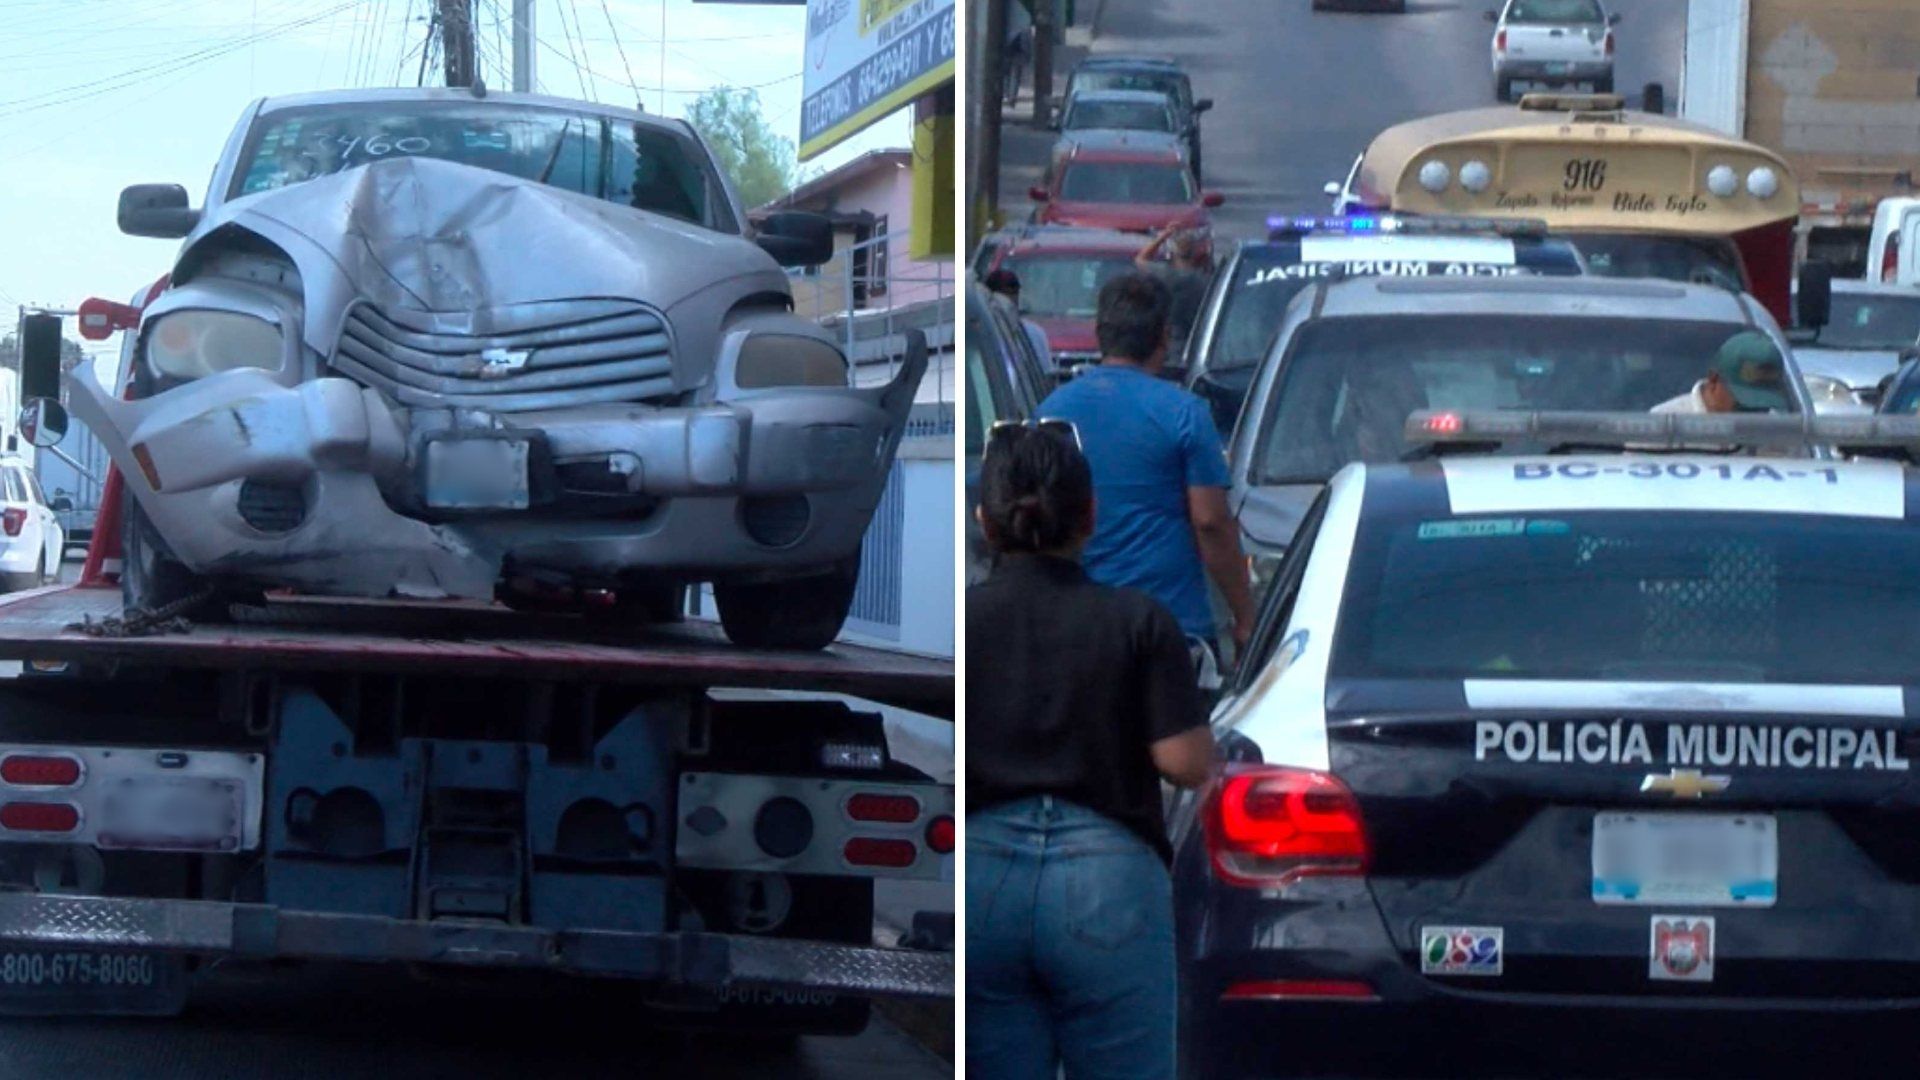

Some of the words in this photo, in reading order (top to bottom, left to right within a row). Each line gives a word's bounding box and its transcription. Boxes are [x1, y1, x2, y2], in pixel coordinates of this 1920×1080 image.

[927, 21, 939, 64] Y
[1563, 158, 1608, 191] 916
[1513, 461, 1840, 485] BC-301A-1
[1474, 718, 1653, 764] POLICÍA
[1667, 723, 1910, 771] MUNICIPAL
